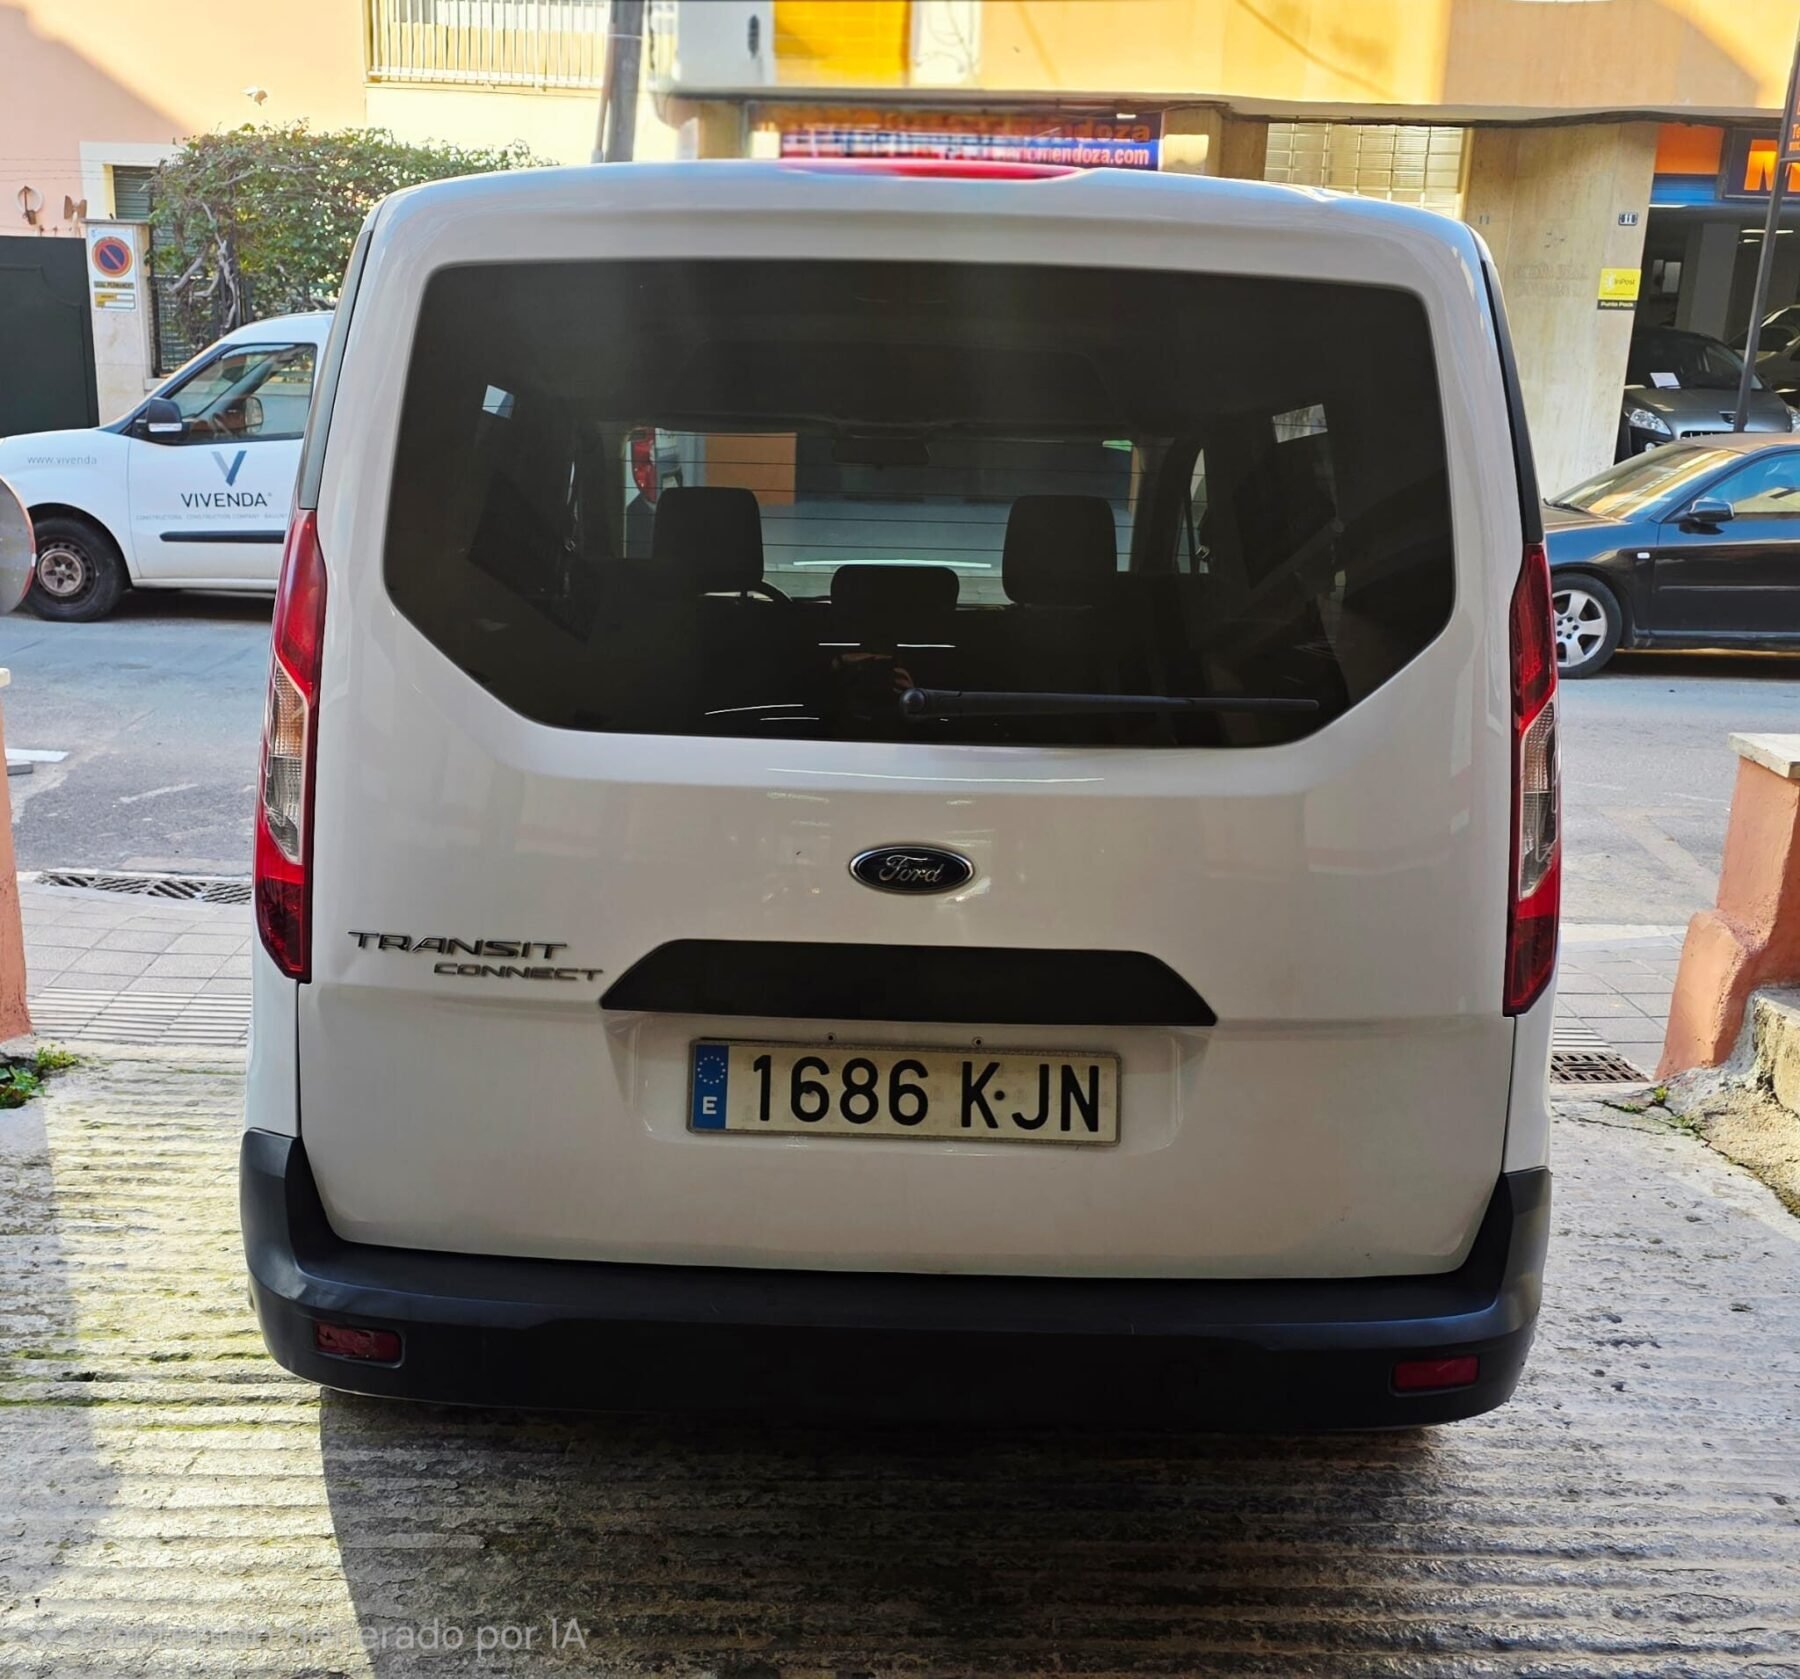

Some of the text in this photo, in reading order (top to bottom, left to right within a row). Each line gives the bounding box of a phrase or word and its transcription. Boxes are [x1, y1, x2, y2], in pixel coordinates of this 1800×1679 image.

[878, 854, 945, 882] Ford
[347, 931, 568, 960] TRANSIT
[433, 962, 604, 982] CONNECT
[702, 1096, 717, 1115] E
[752, 1054, 1100, 1132] 1686 KJN
